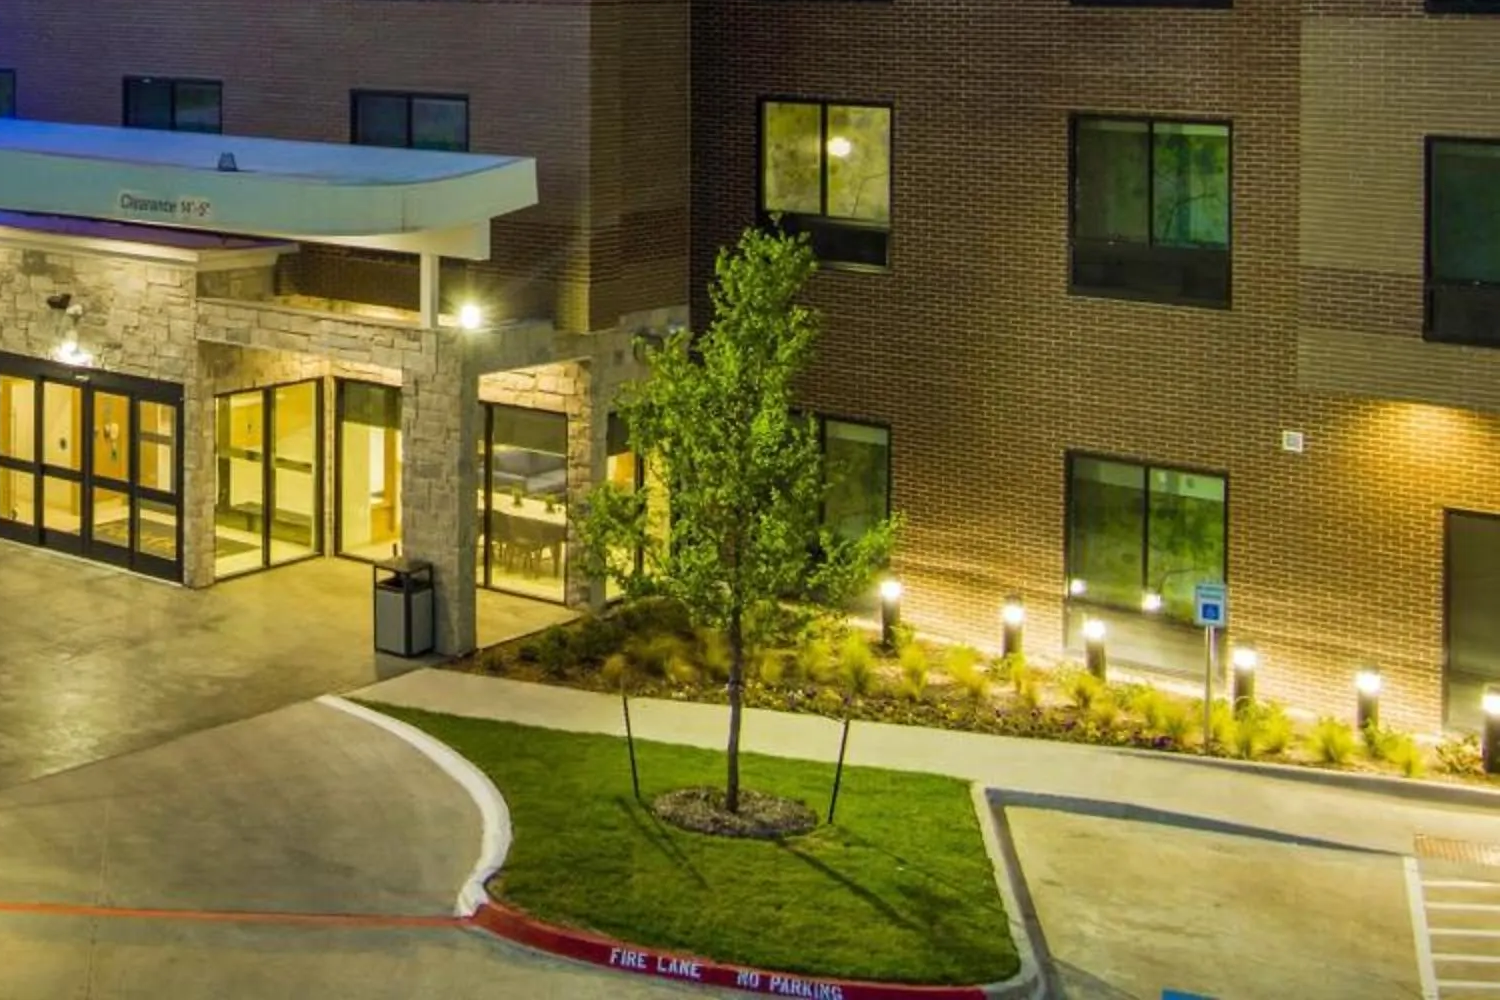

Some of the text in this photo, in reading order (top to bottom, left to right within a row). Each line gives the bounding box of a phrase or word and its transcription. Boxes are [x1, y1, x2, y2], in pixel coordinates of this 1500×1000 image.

[609, 947, 843, 1000] FIRE LANE NO PARKING
